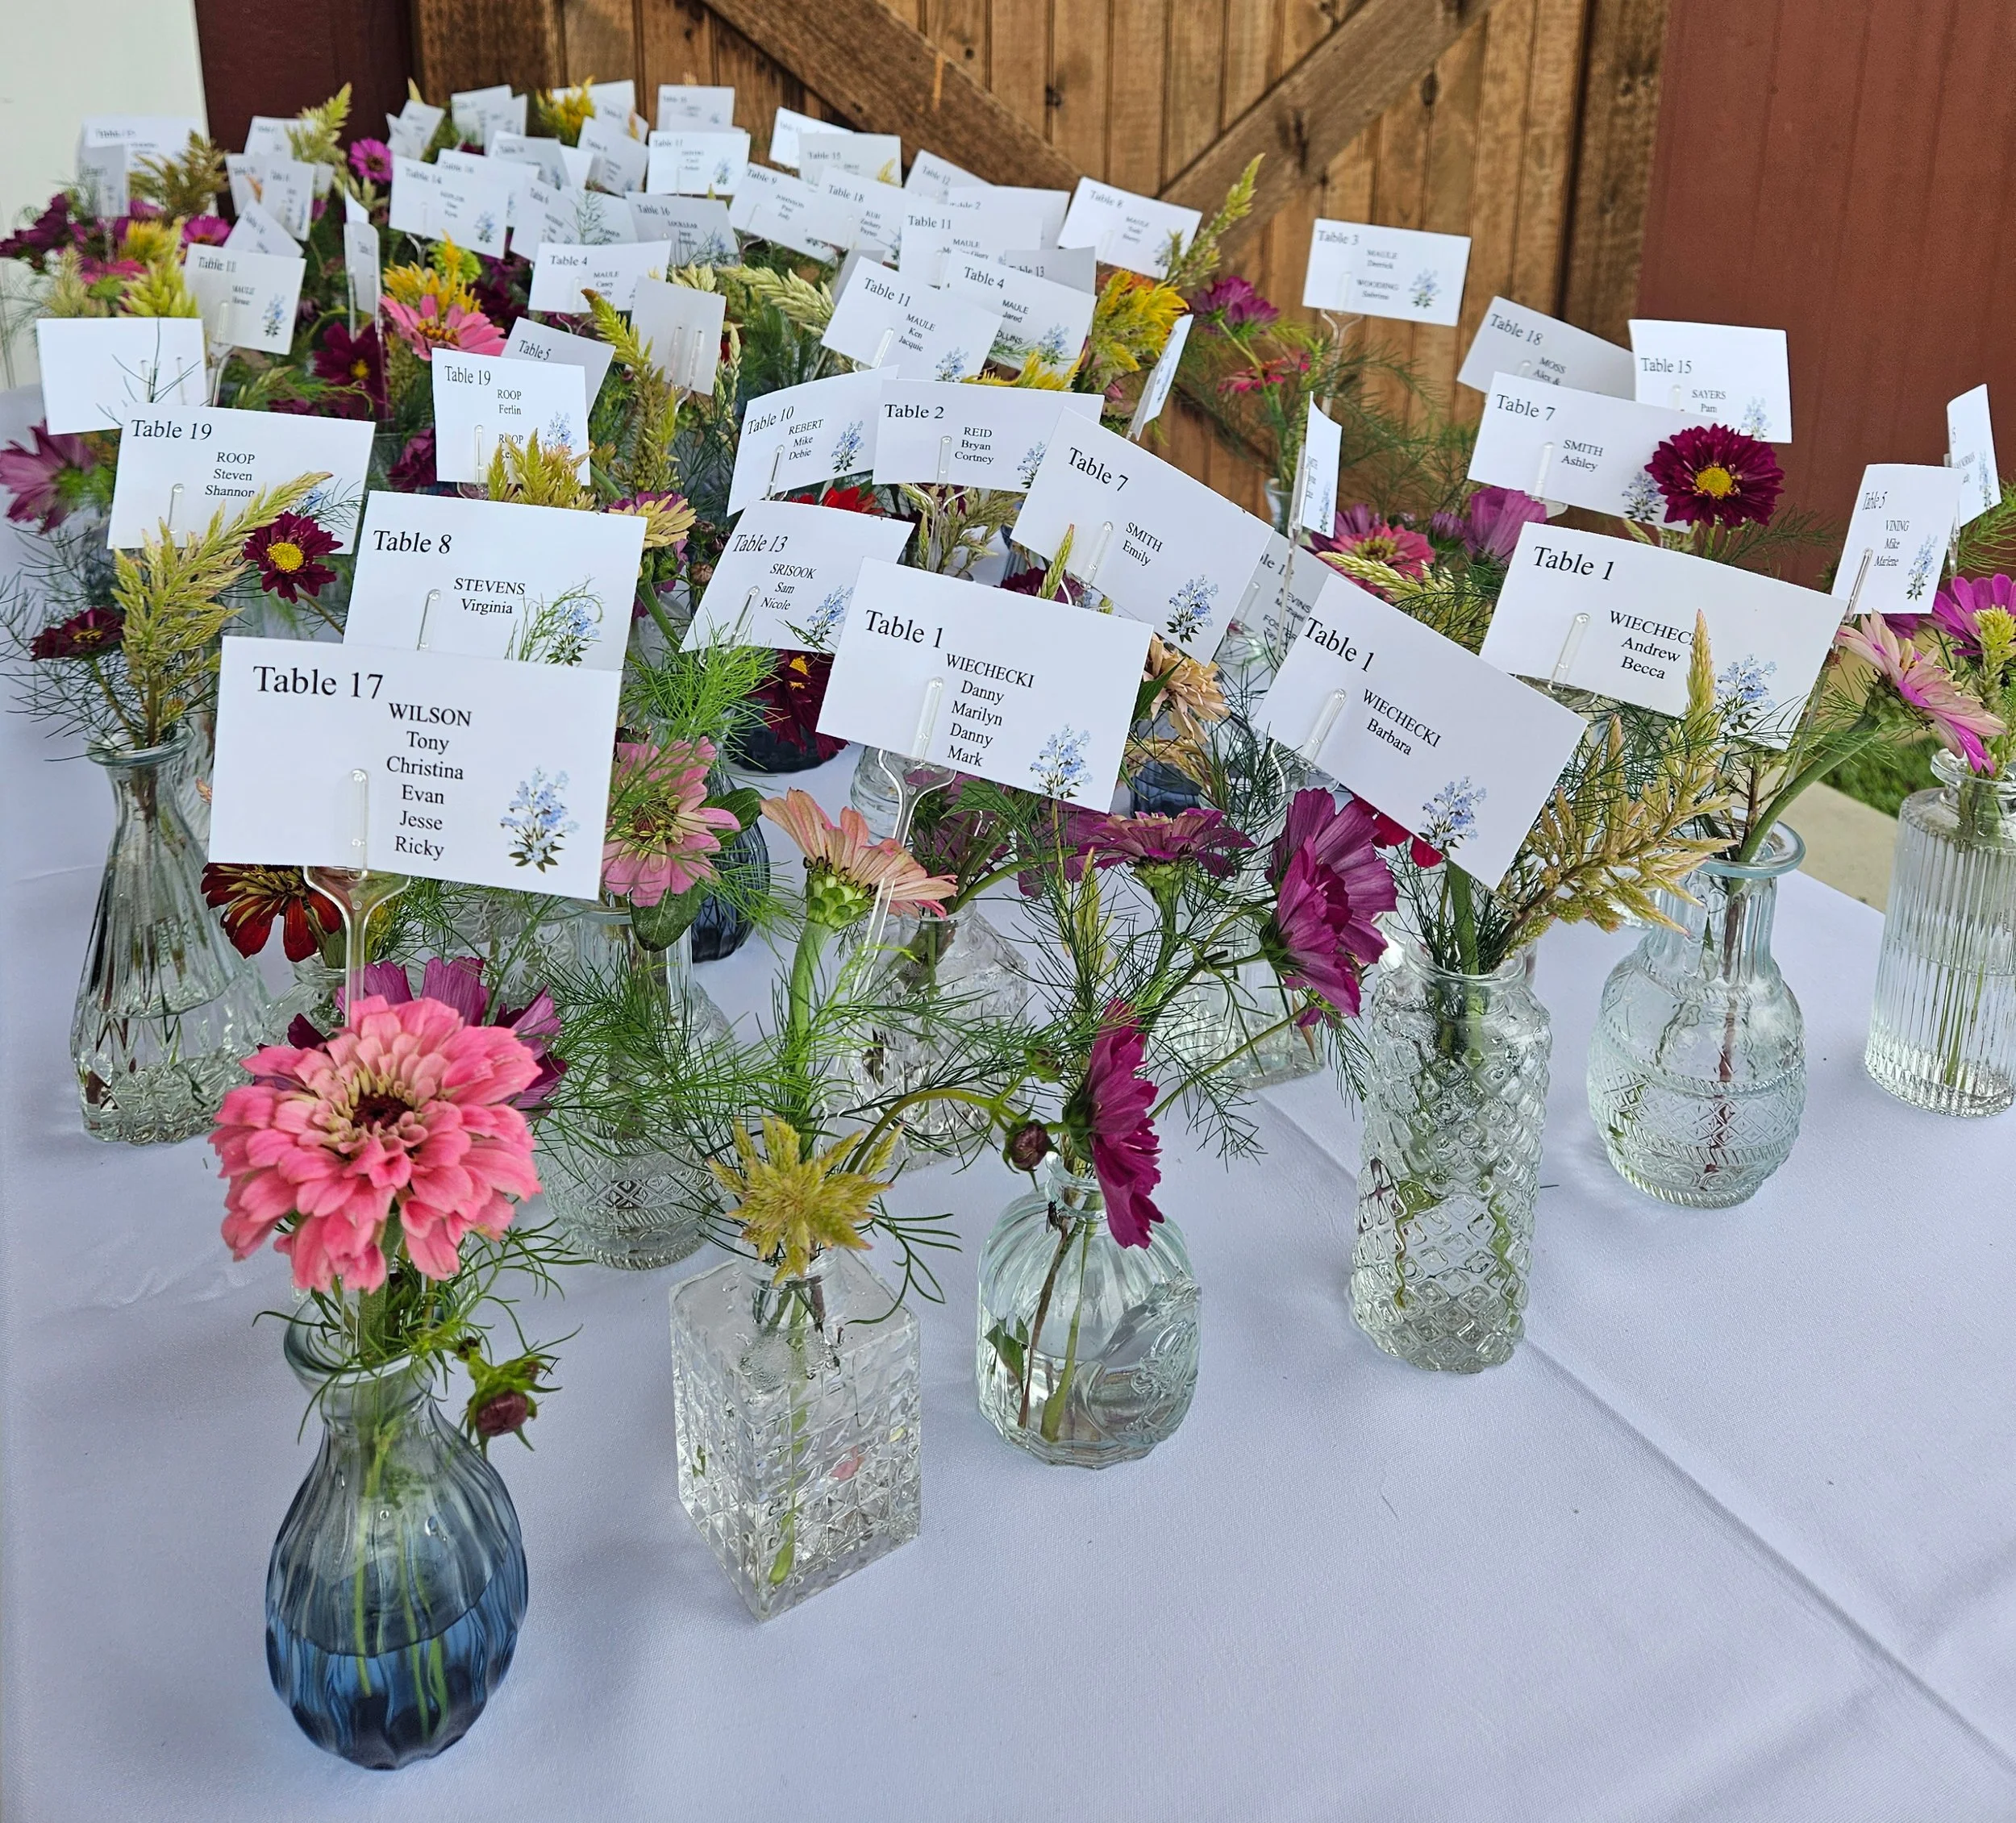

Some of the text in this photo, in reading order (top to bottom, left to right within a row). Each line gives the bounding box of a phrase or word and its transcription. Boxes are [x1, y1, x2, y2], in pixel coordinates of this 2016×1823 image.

[748, 169, 768, 182] Table
[922, 166, 951, 186] Table 12
[828, 185, 865, 202] Table 18
[1090, 190, 1114, 206] Table
[637, 204, 670, 215] Table 16
[908, 215, 952, 229] Table 11
[953, 239, 981, 248] MAULE
[1318, 231, 1360, 245] Table 3
[550, 255, 588, 266] Table 4
[593, 270, 620, 278] MAULE
[964, 266, 1006, 289] Table 4
[1035, 266, 1045, 277] 13
[864, 277, 911, 308] Table 11
[1002, 299, 1029, 314] MAULE
[906, 314, 936, 331] MAULE
[1491, 314, 1543, 346] Table 18
[908, 326, 923, 339] Ken
[997, 330, 1023, 345] OLLINS
[519, 339, 552, 360] Table 5
[898, 335, 924, 352] Jacquie
[1539, 357, 1567, 374] MOSS
[1641, 357, 1692, 374] Table 15
[444, 365, 491, 386] Table 19
[497, 389, 522, 401] ROOP
[1692, 389, 1727, 401] SAYERS
[498, 403, 522, 415] Ferlin
[884, 403, 944, 419] Table 2
[1497, 394, 1556, 422] Table 7
[1701, 403, 1718, 414] Pam
[131, 419, 212, 440] Table 19
[747, 406, 795, 435] Table 10
[788, 419, 824, 435] REBERT
[793, 435, 814, 447] Mike
[963, 427, 992, 439] REID
[788, 448, 812, 460] Debie
[960, 439, 991, 453] Bryan
[1563, 439, 1604, 458] SMITH
[216, 452, 255, 464] ROOP
[954, 451, 994, 465] Cortney
[1560, 454, 1598, 472] Ashley
[213, 468, 252, 481] Steven
[1068, 447, 1129, 492] Table 7
[205, 485, 255, 497] Shannon
[1862, 491, 1889, 510] Table 5
[1885, 520, 1910, 532] VINING
[373, 530, 452, 554] Table 8
[732, 534, 788, 552] Table 13
[1125, 522, 1164, 553] SMITH
[1885, 538, 1900, 549] Mike
[1123, 540, 1152, 567] Emily
[769, 563, 817, 580] SRISOOK
[1534, 547, 1614, 581] Table 1
[454, 577, 525, 595] STEVENS
[775, 582, 794, 594] Sam
[460, 598, 513, 615] Virginia
[760, 597, 790, 610] Nicole
[1275, 597, 1306, 622] Mhael
[865, 610, 943, 649] Table 1
[1610, 610, 1711, 646] WIECHEC
[1304, 617, 1357, 663] Table
[1360, 652, 1374, 672] 1
[1621, 636, 1681, 664] Andrew
[946, 653, 1035, 688] WIECHECKI
[1621, 656, 1665, 680] Becca
[253, 666, 384, 700] Table 17
[960, 680, 1005, 705] Danny
[388, 702, 473, 726] WILSON
[952, 701, 1003, 726] Marilyn
[1363, 689, 1441, 748] WIECHECKI
[406, 731, 449, 755] Tony
[950, 722, 993, 748] Danny
[1366, 718, 1411, 755] Barbara
[947, 745, 983, 768] Mark
[386, 755, 464, 780] Christina
[402, 785, 444, 805] Evan
[399, 810, 444, 830] Jesse
[394, 835, 444, 860] Ricky
